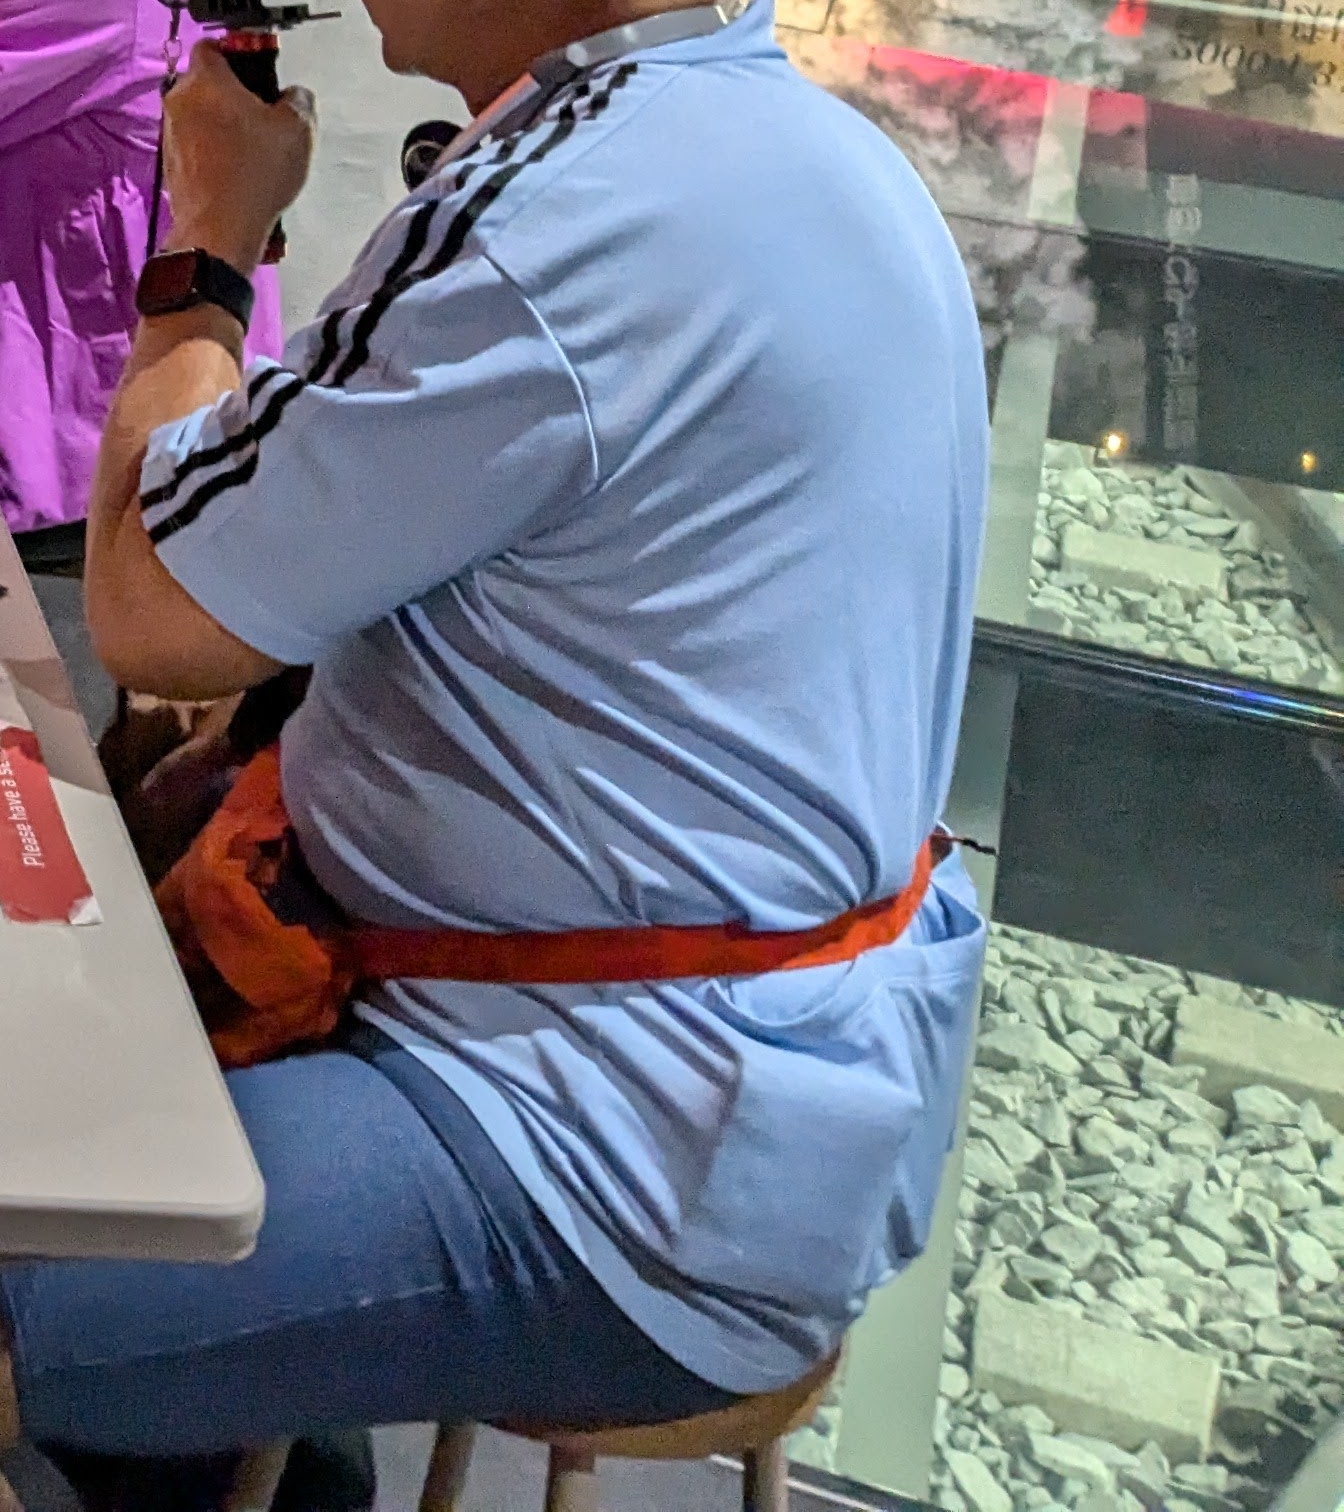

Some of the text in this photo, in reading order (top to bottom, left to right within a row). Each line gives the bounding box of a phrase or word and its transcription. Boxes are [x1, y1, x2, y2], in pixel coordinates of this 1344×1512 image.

[1, 777, 17, 789] a
[7, 789, 29, 822] have
[21, 822, 45, 869] Please
